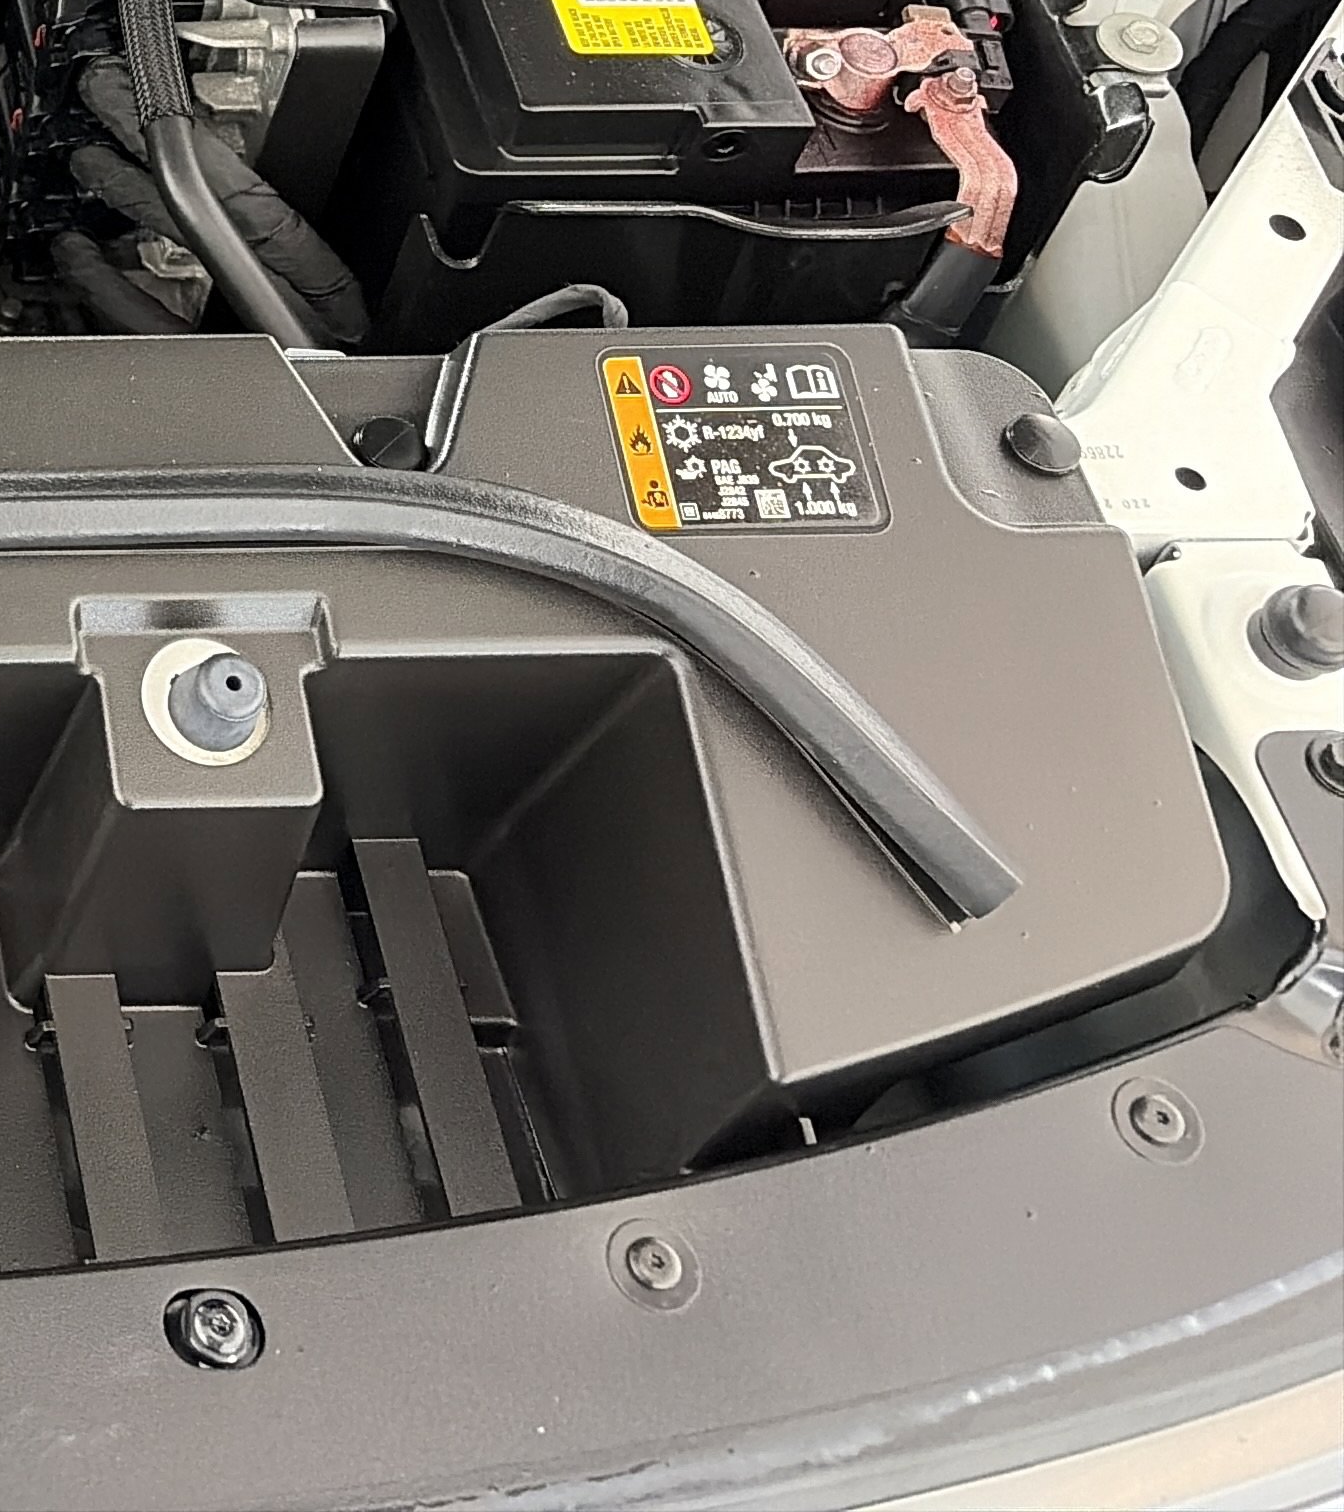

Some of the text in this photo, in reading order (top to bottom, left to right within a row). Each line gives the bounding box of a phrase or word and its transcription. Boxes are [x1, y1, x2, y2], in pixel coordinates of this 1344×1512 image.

[707, 390, 739, 404] AUTO
[772, 412, 833, 429] 0.700 kg
[702, 424, 765, 441] R-1234yf
[710, 459, 742, 474] PAG
[795, 500, 858, 516] 1.000 kg
